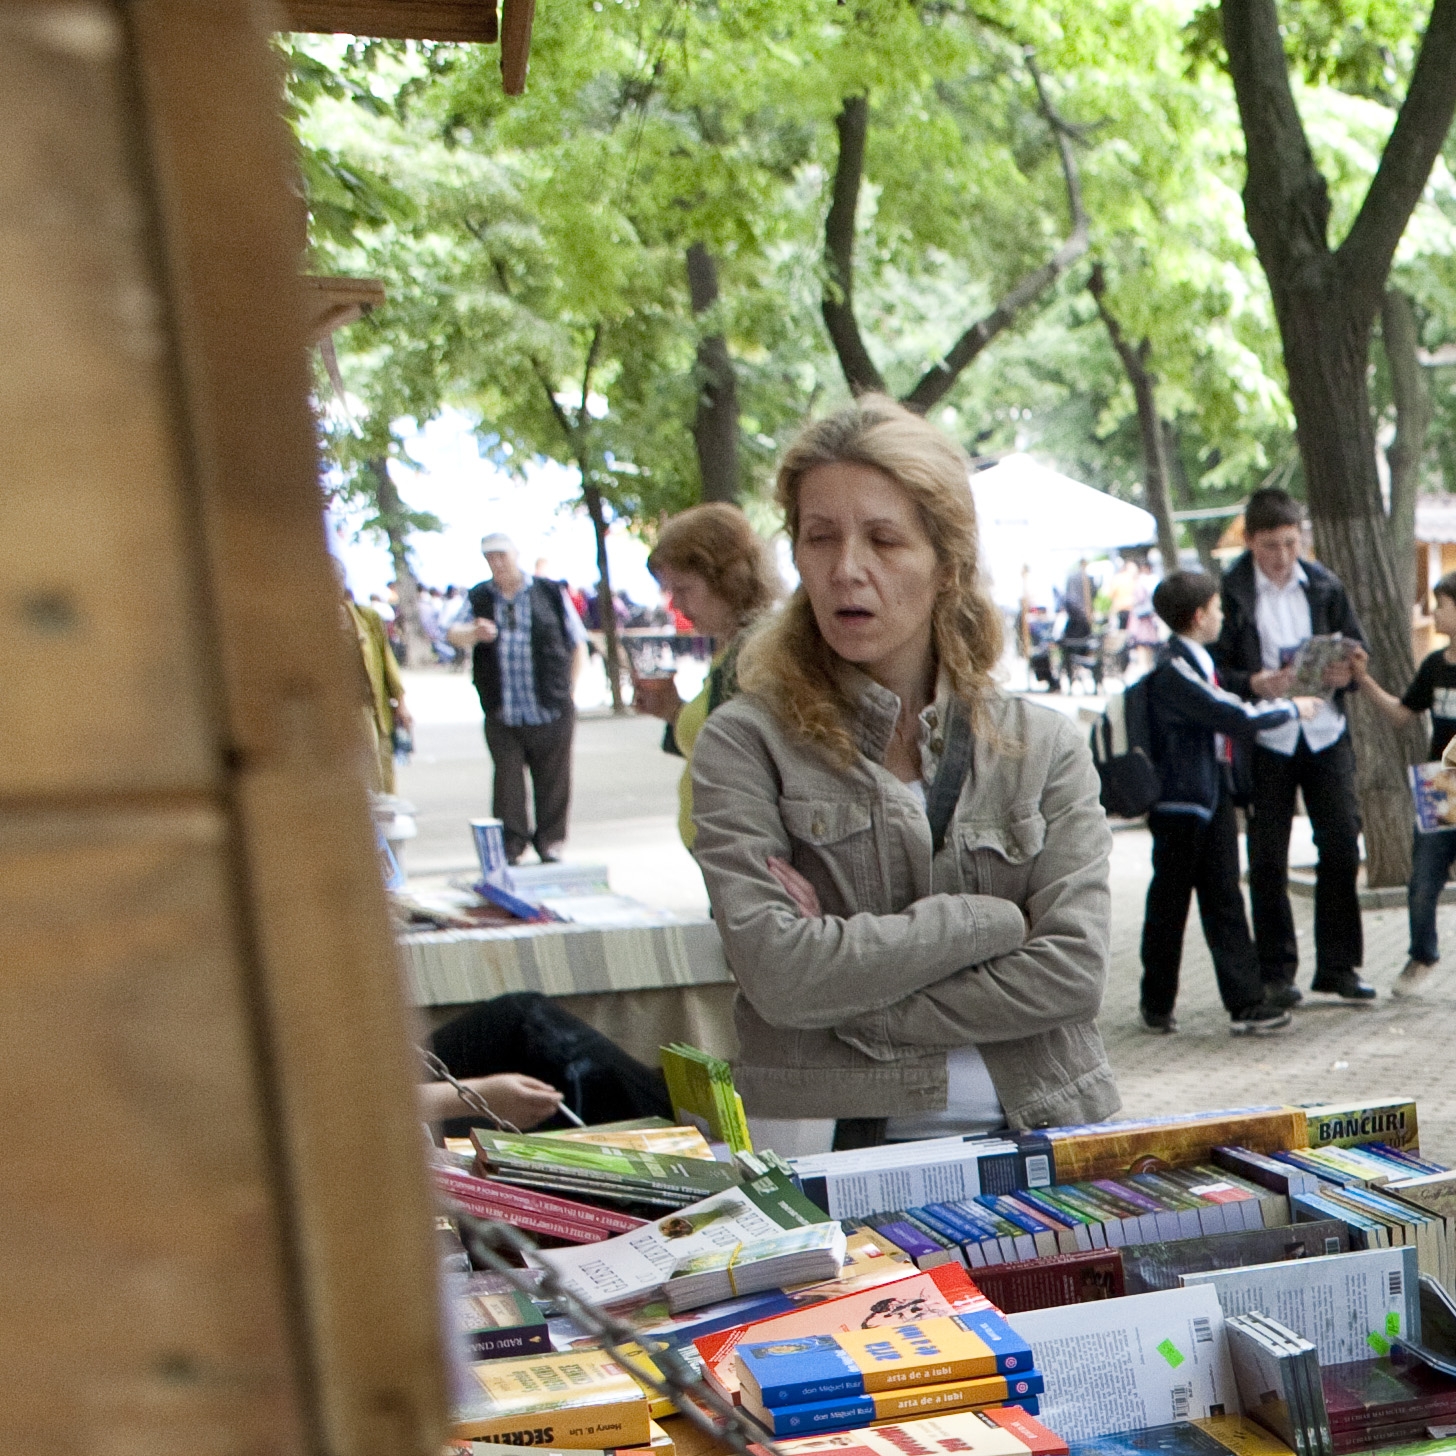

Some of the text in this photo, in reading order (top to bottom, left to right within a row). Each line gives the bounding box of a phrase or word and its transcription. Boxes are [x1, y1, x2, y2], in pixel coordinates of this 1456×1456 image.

[1318, 1111, 1405, 1141] BANCURI
[497, 1336, 522, 1348] RADU
[886, 1372, 906, 1382] arta
[909, 1370, 921, 1380] de
[897, 1400, 918, 1408] arta
[919, 1396, 933, 1406] de
[569, 1422, 621, 1436] Henry B. Lin
